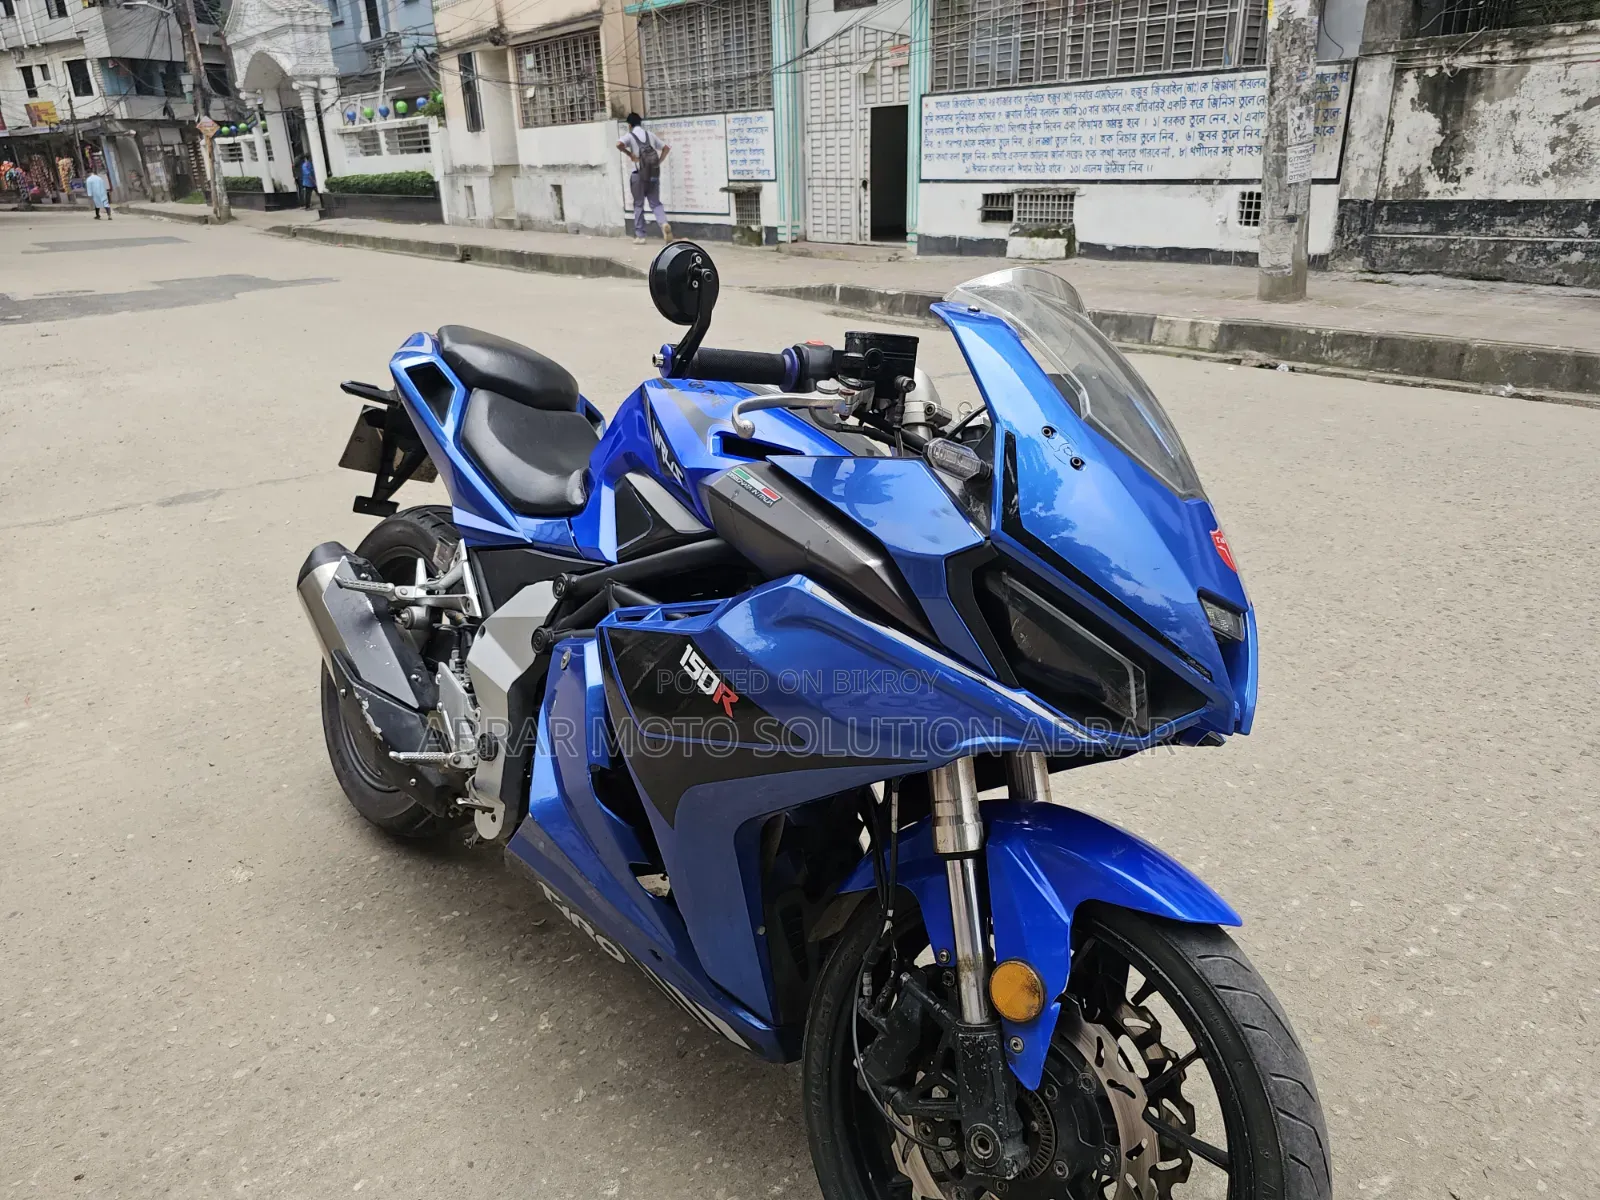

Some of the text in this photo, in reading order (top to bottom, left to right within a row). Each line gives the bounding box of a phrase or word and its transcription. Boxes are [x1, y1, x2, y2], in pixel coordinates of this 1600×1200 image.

[1130, 87, 1148, 99] হুজুর
[1151, 81, 1183, 96] জিবরাইল
[1200, 82, 1209, 93] কে
[1239, 77, 1266, 89] করলেন
[1167, 97, 1187, 111] একটি
[1189, 99, 1204, 109] করে
[1207, 94, 1236, 109] জিনিস
[1238, 95, 1256, 109] তুলে
[1126, 118, 1140, 128] হবে
[1162, 115, 1186, 127] বরকত
[1189, 114, 1206, 128] তুলে
[1100, 135, 1114, 144] হক
[1116, 130, 1137, 144] বিচার
[1140, 133, 1156, 145] তুলে
[1222, 129, 1240, 143] তুলে
[1237, 144, 1263, 157] সাহস
[1128, 160, 1144, 173] নিব
[679, 644, 739, 718] 150R
